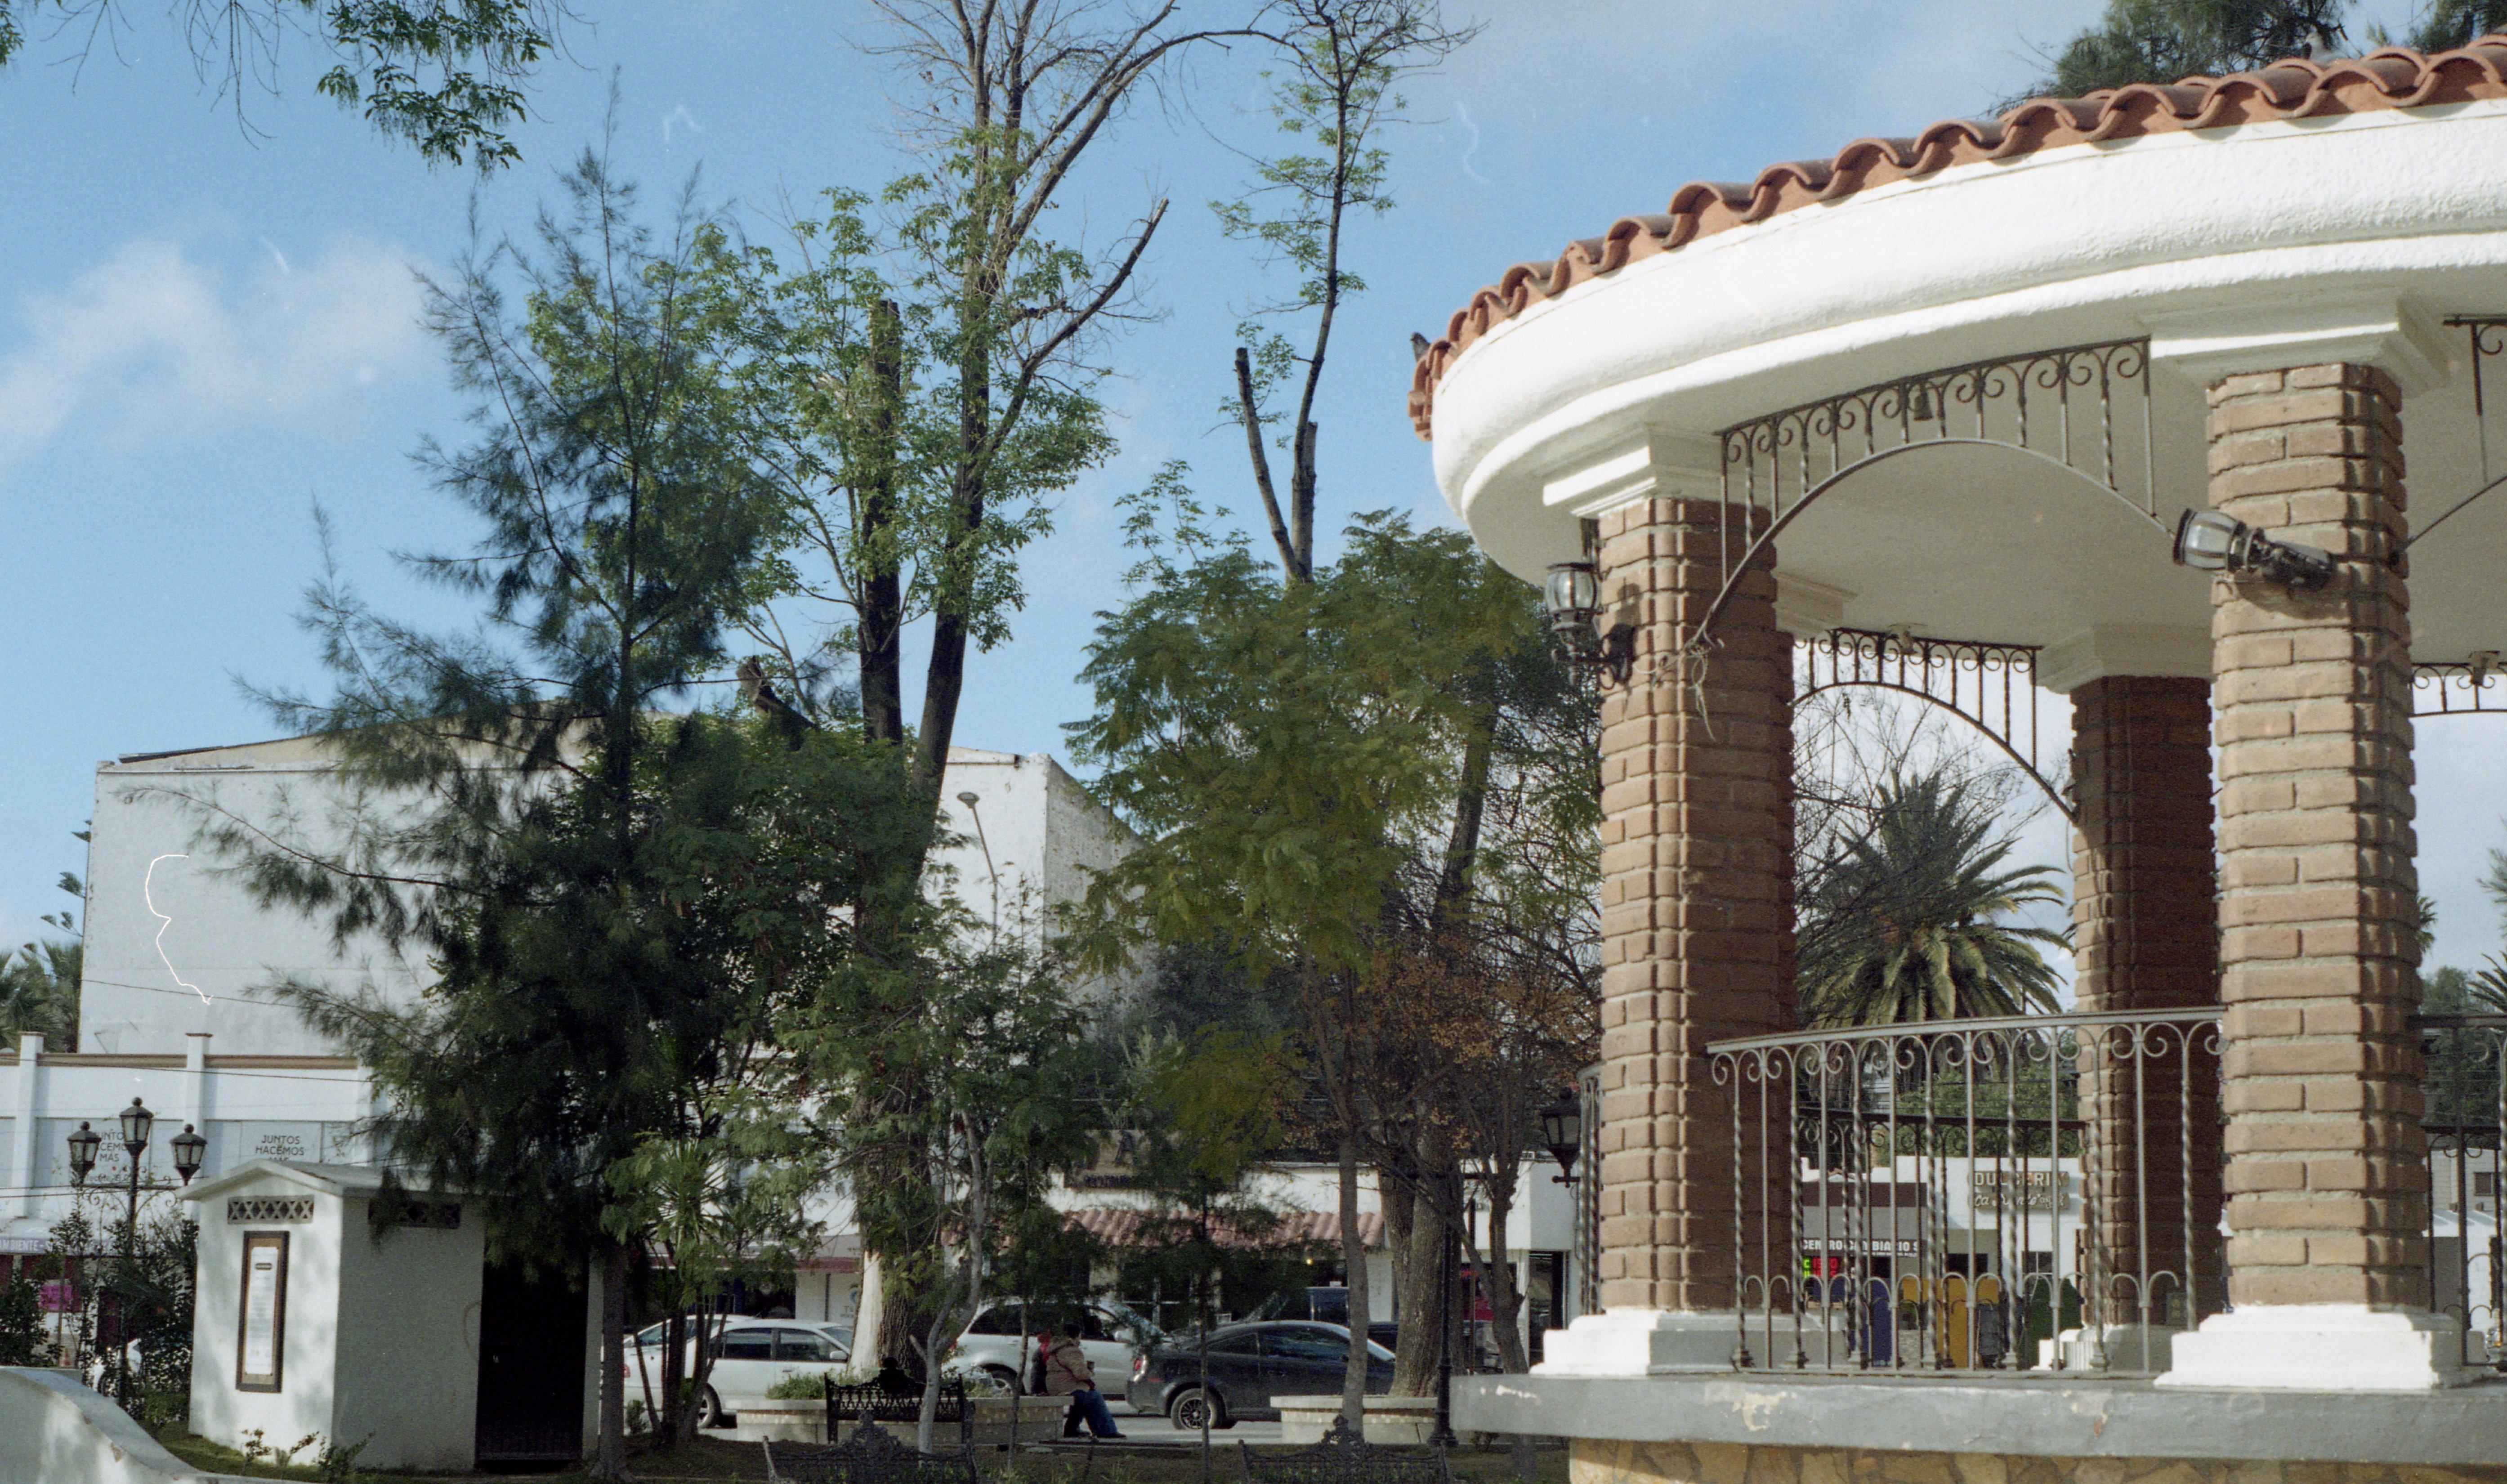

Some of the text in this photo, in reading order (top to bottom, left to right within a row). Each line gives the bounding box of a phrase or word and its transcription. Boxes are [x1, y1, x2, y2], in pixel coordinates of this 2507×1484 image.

[98, 1131, 124, 1140] UNTO
[261, 1135, 300, 1144] JUNTOS
[255, 1145, 304, 1156] HACEMOS
[1975, 1172, 2062, 1186] DULERI
[1802, 1239, 1843, 1250] CENRO
[1849, 1240, 1910, 1252] CMBIAIO
